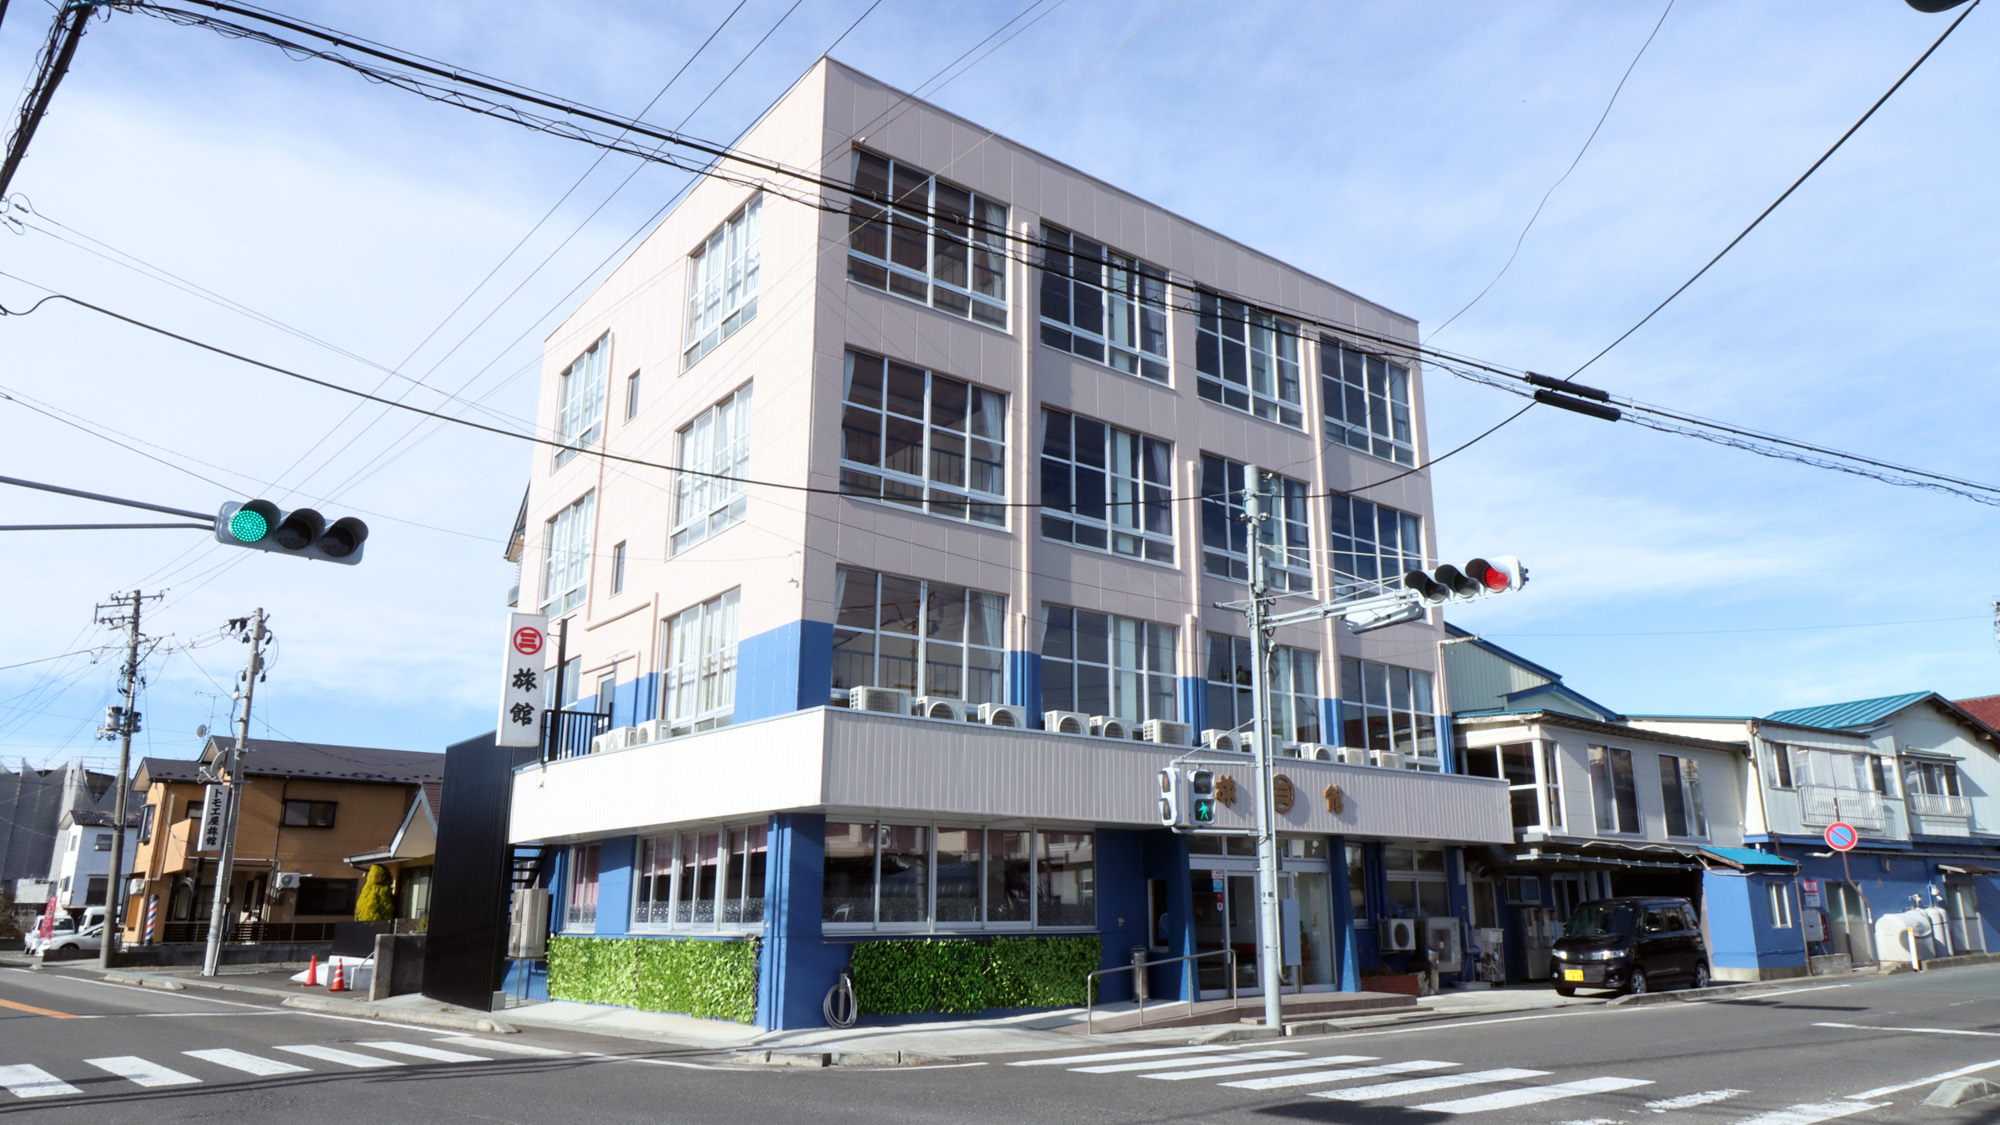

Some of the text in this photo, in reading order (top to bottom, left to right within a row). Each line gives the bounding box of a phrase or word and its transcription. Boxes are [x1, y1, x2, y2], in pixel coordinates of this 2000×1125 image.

[510, 667, 537, 727] 旅館
[206, 788, 223, 846] トモエ屋旅館
[1323, 784, 1344, 814] 館
